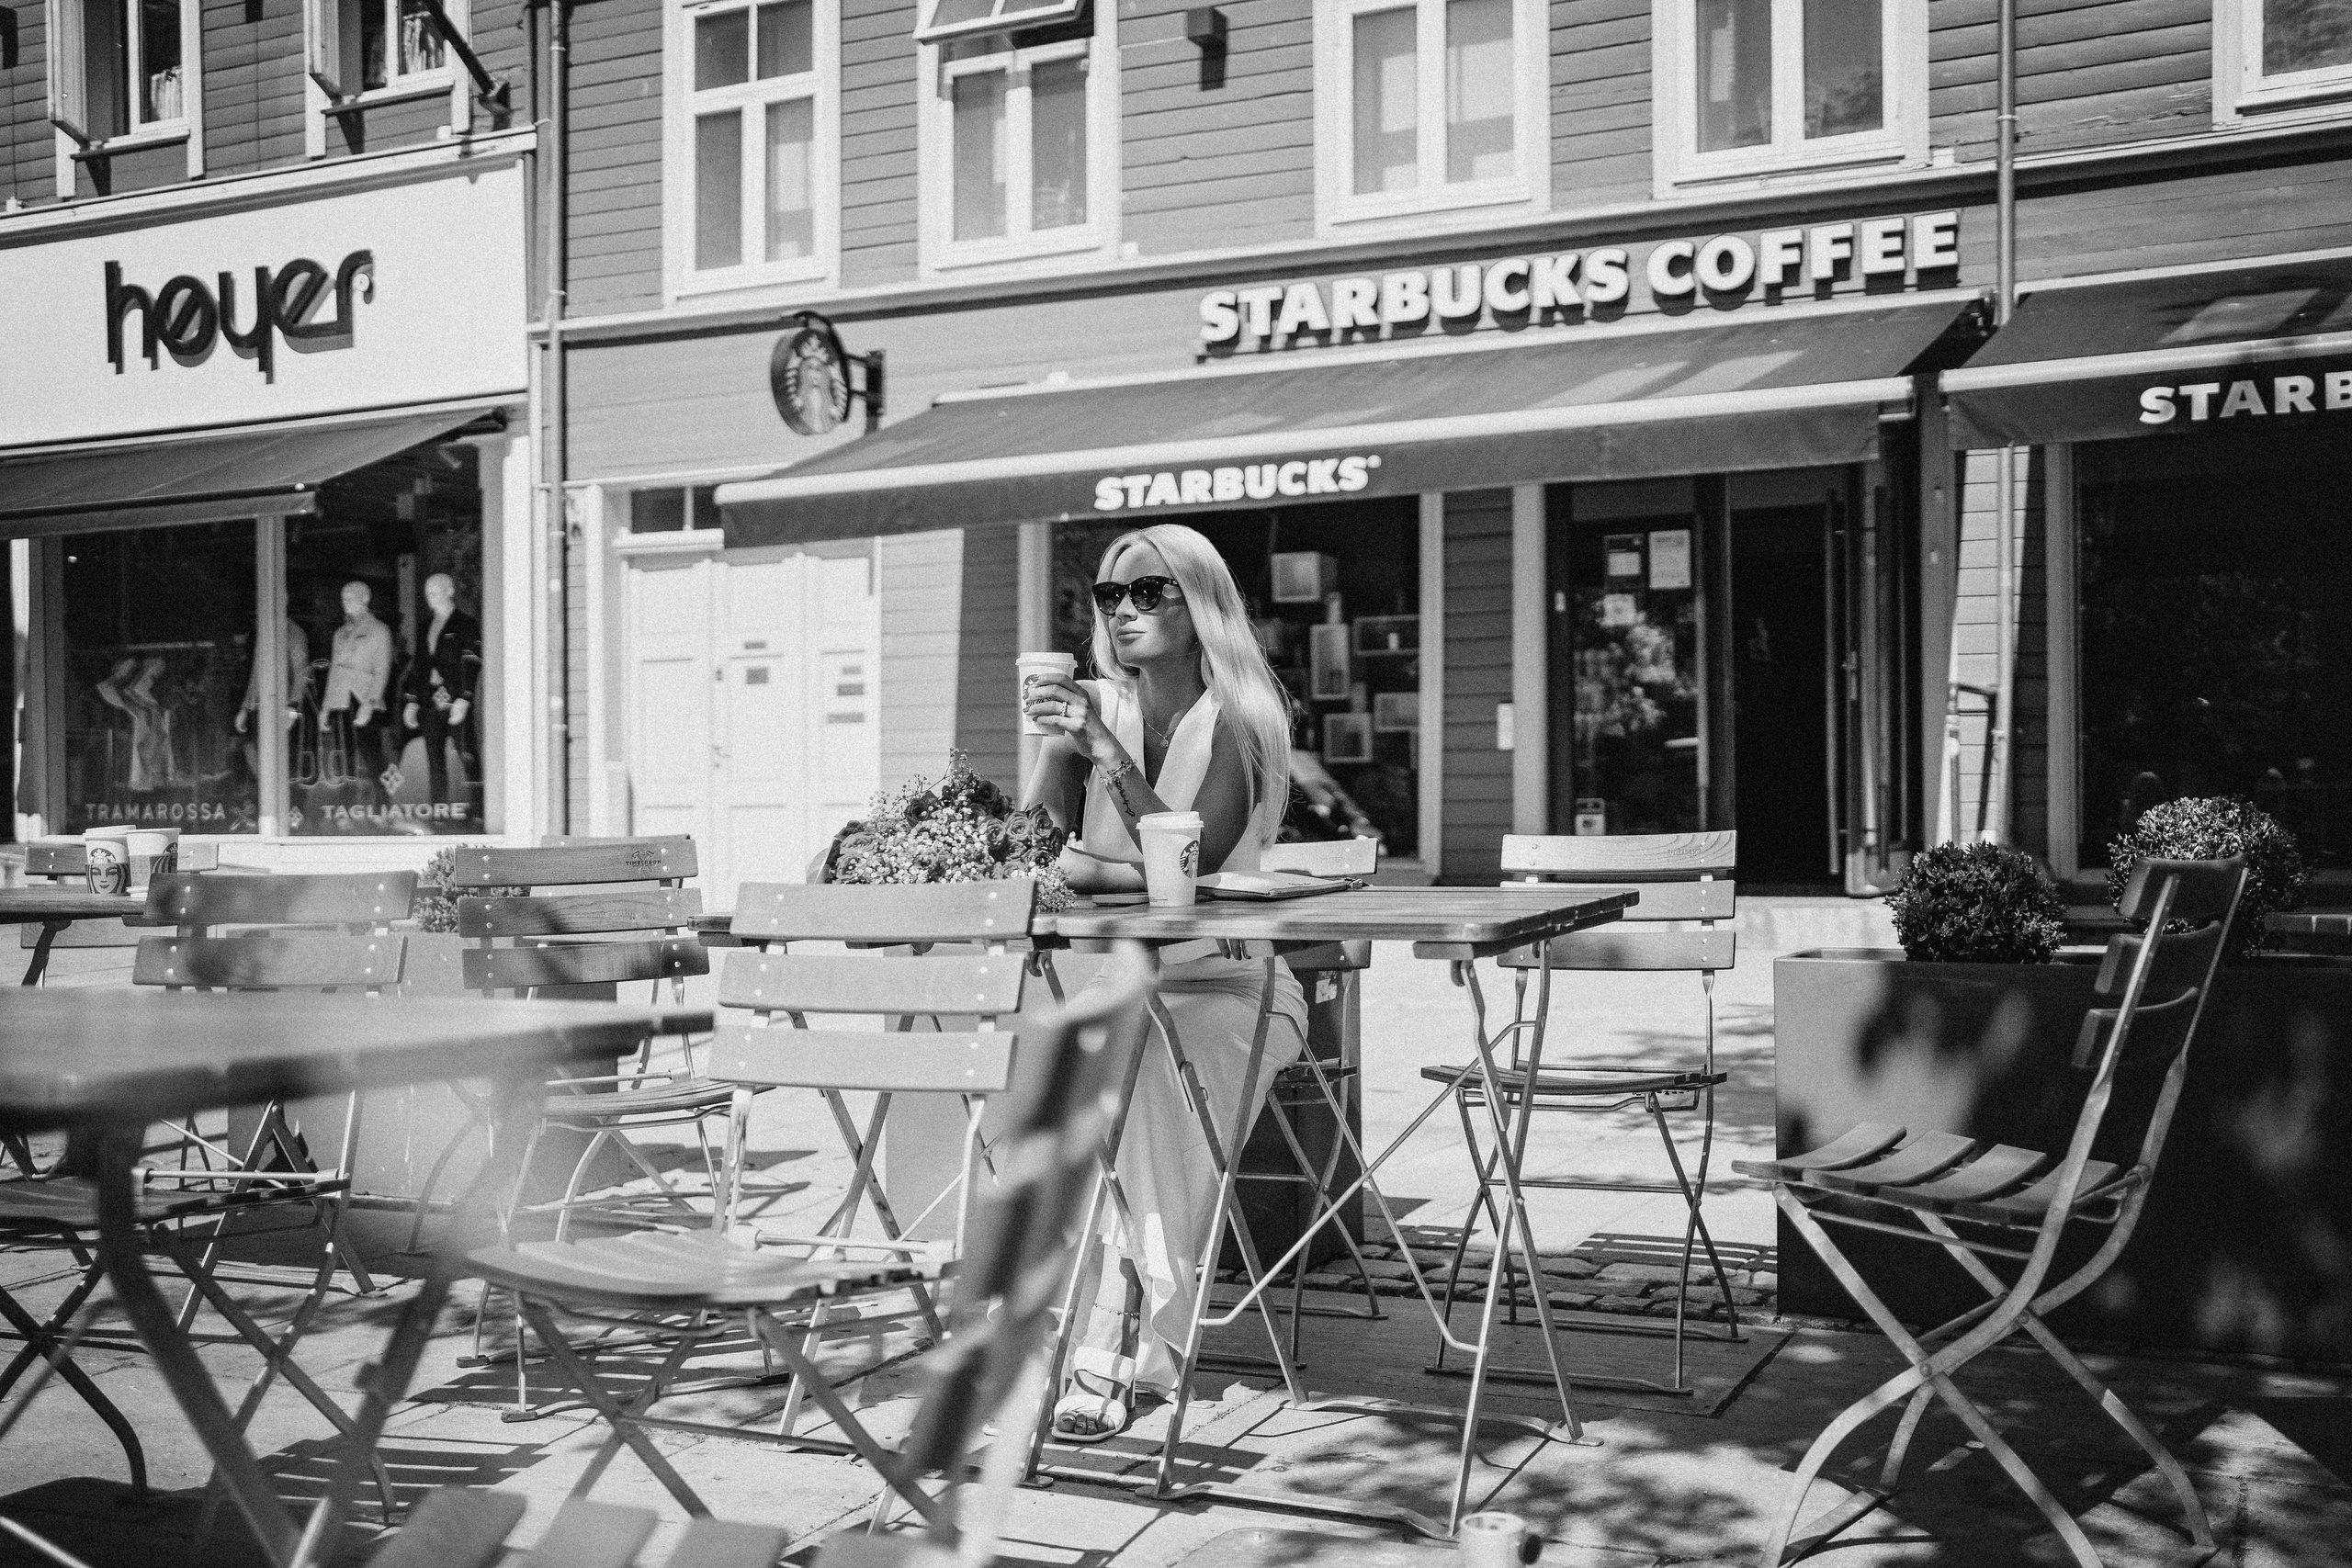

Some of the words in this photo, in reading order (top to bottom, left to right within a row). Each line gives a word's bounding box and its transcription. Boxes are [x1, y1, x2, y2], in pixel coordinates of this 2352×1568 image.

[1199, 248, 1629, 342] STARBUCKS
[1647, 210, 1959, 296] COFFEE
[85, 803, 226, 820] TRAMAROSSA
[322, 802, 469, 820] TAGLIATORE
